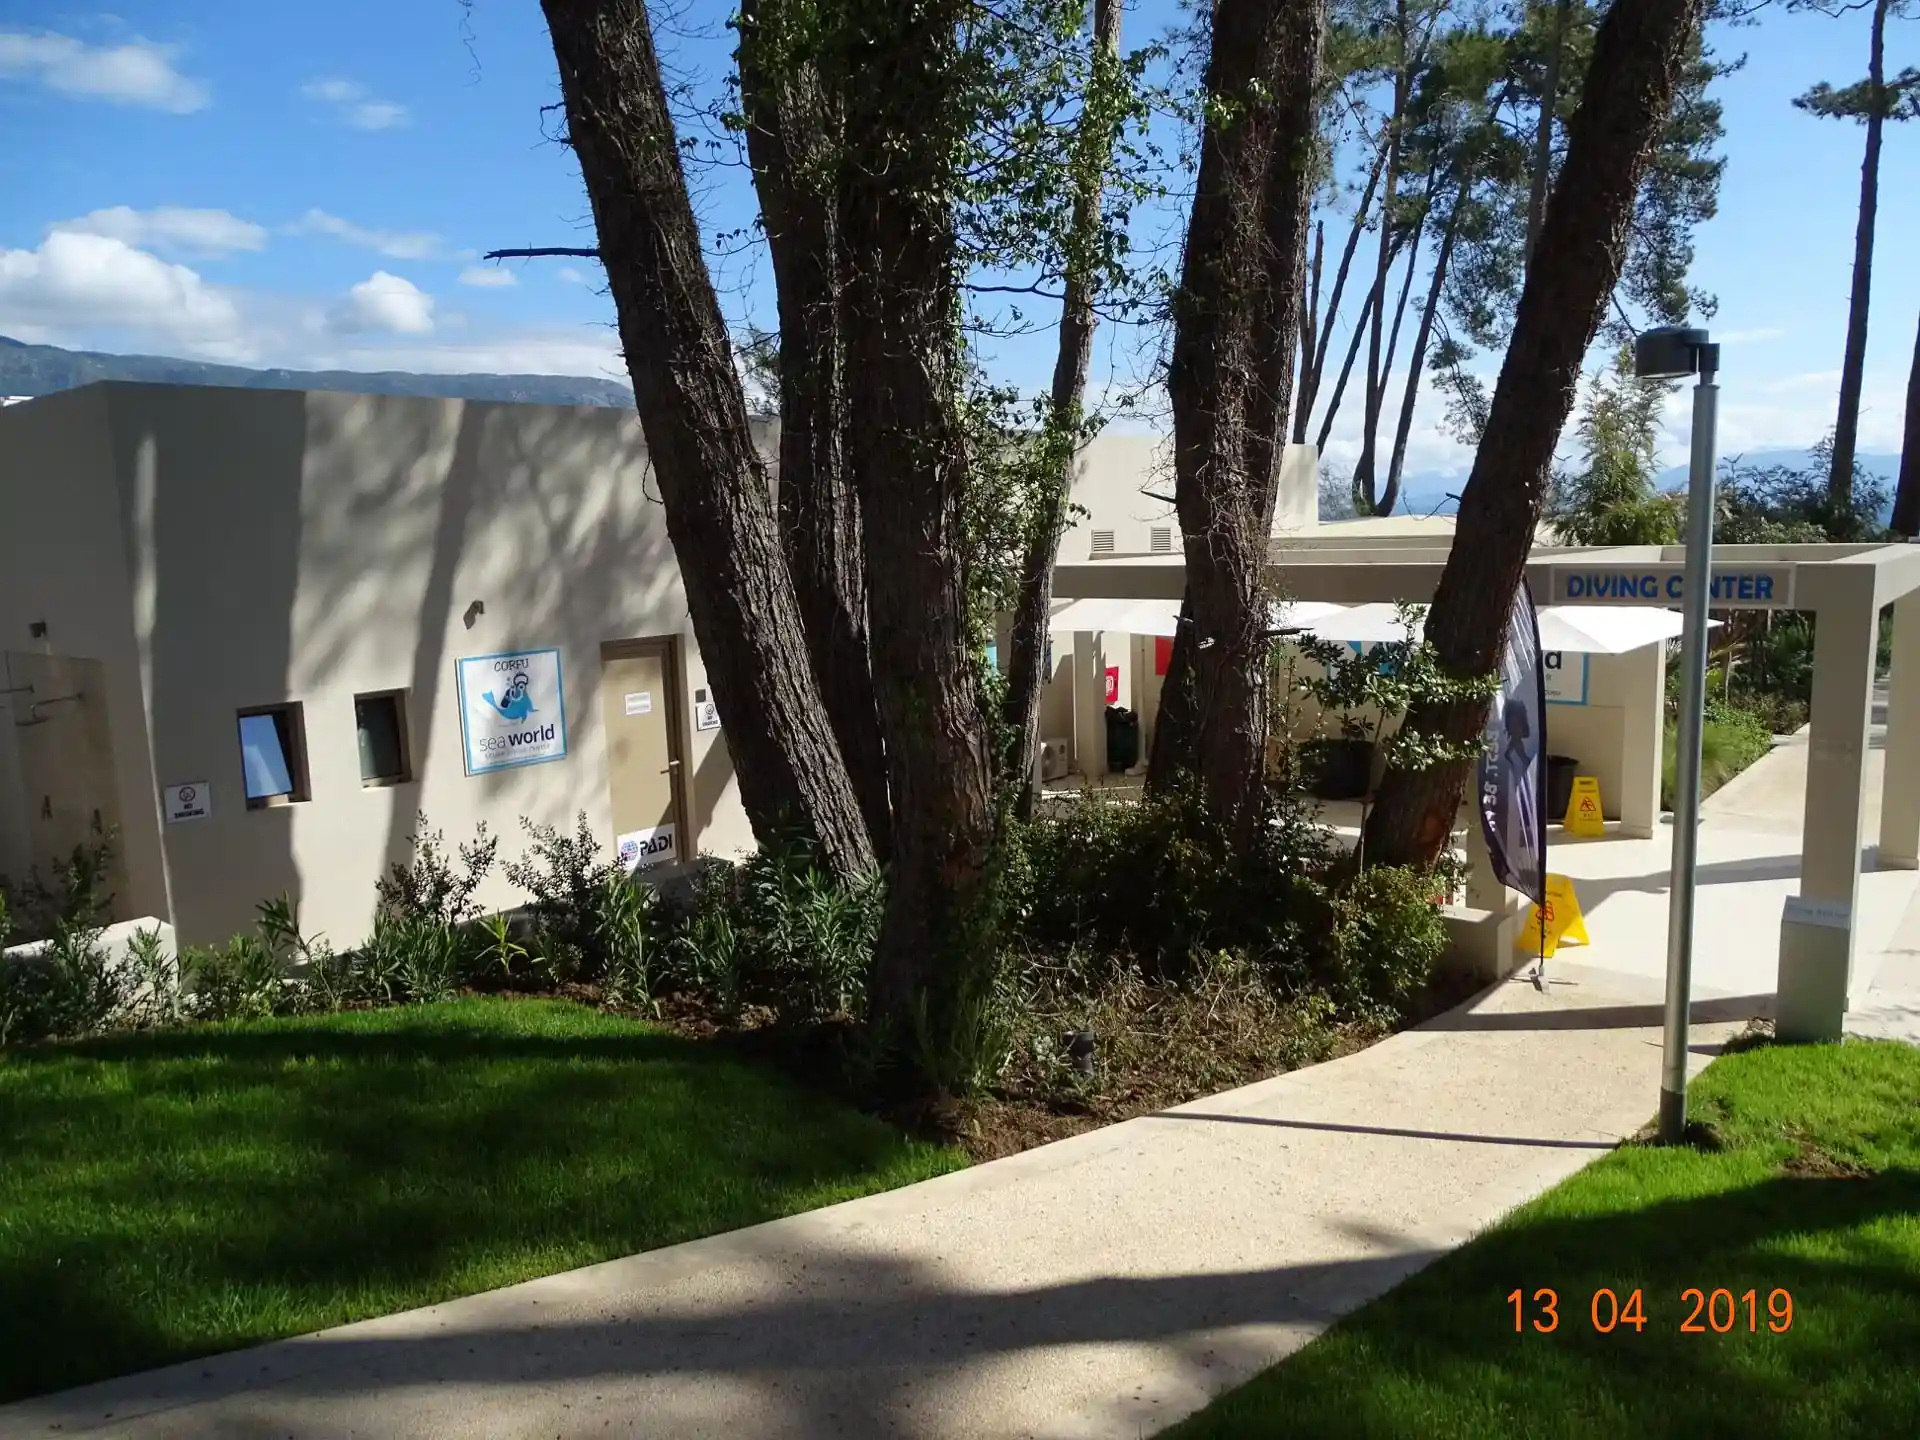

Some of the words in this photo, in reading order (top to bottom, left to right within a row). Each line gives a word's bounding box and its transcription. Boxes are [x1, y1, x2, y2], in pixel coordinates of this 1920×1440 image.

[1566, 574, 1658, 598] DIVING
[1665, 575, 1774, 599] CNTER
[494, 658, 529, 672] CORFU
[479, 735, 506, 752] sea
[508, 723, 555, 747] world
[639, 833, 672, 856] PADI
